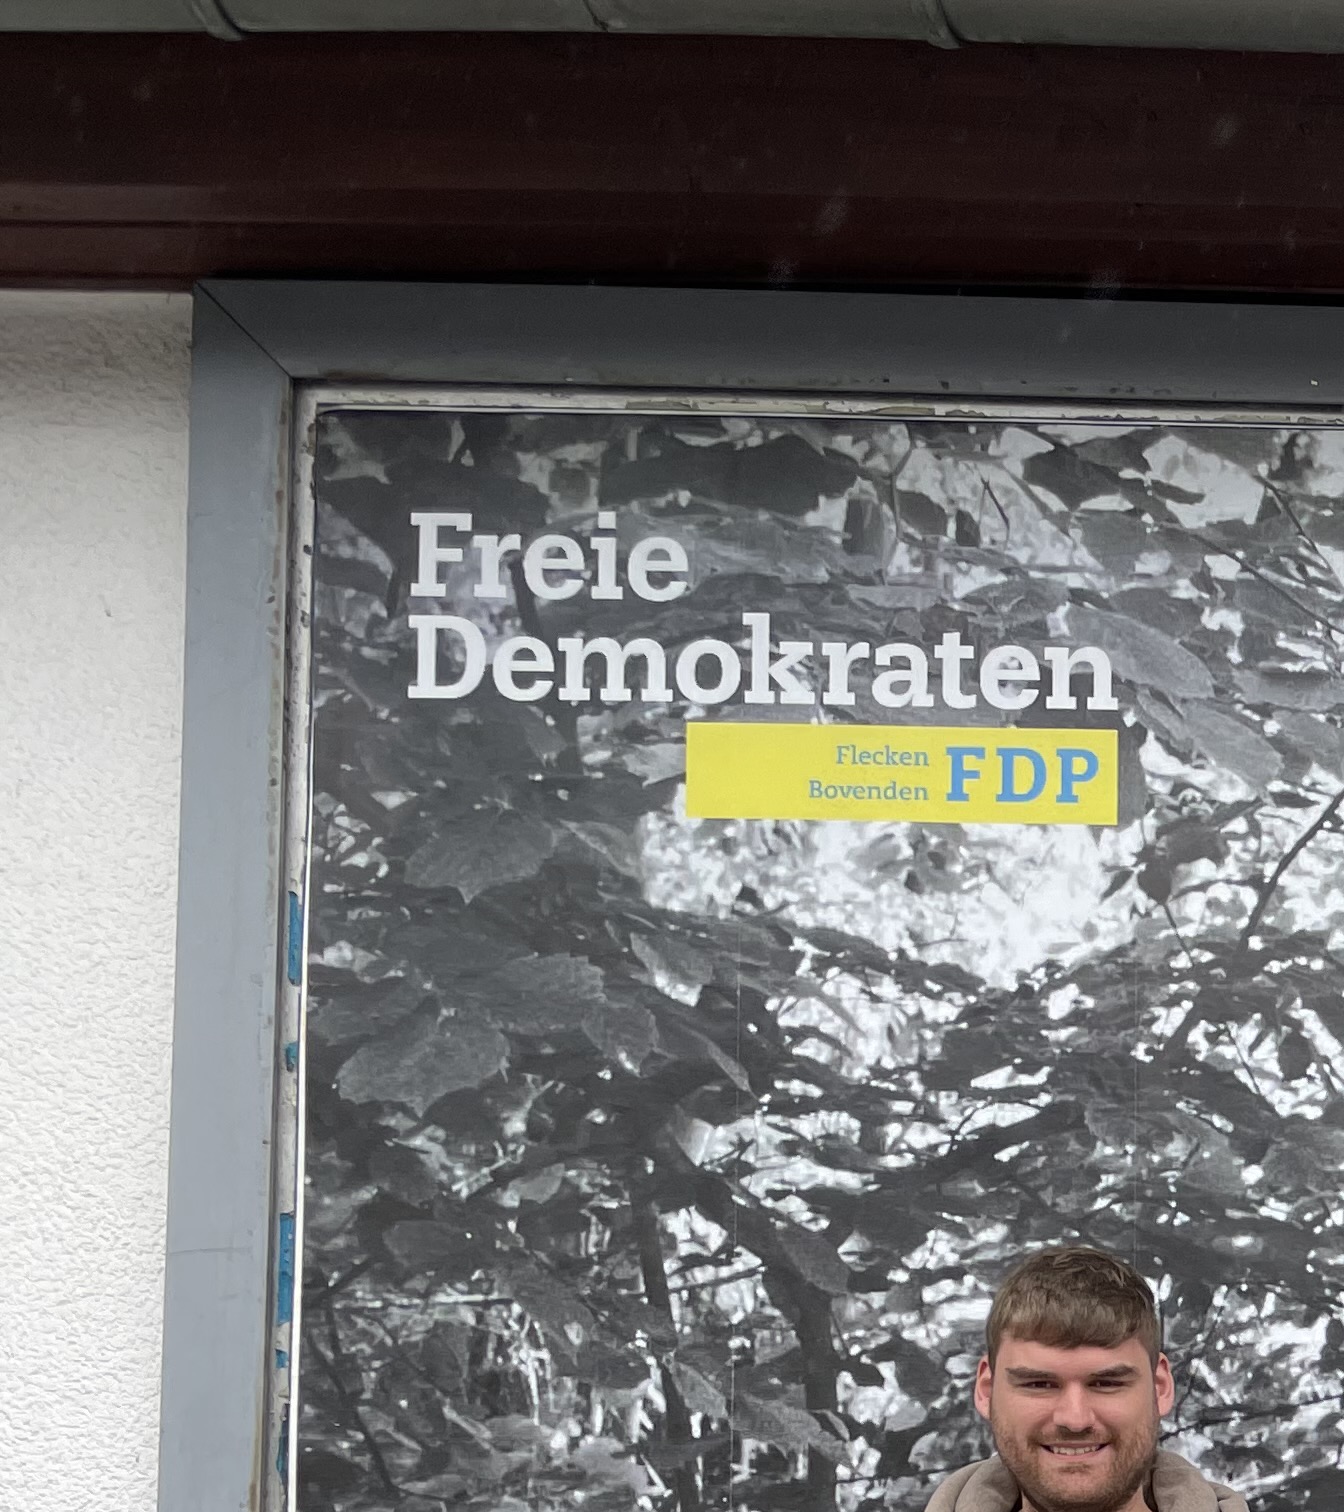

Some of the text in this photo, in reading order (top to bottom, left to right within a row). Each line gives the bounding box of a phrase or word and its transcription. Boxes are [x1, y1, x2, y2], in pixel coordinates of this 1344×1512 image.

[410, 511, 690, 602] Freie
[407, 612, 1120, 711] Demokraten
[836, 744, 931, 768] Flecken
[945, 746, 1100, 804] FDP
[808, 779, 931, 802] Bovenden
